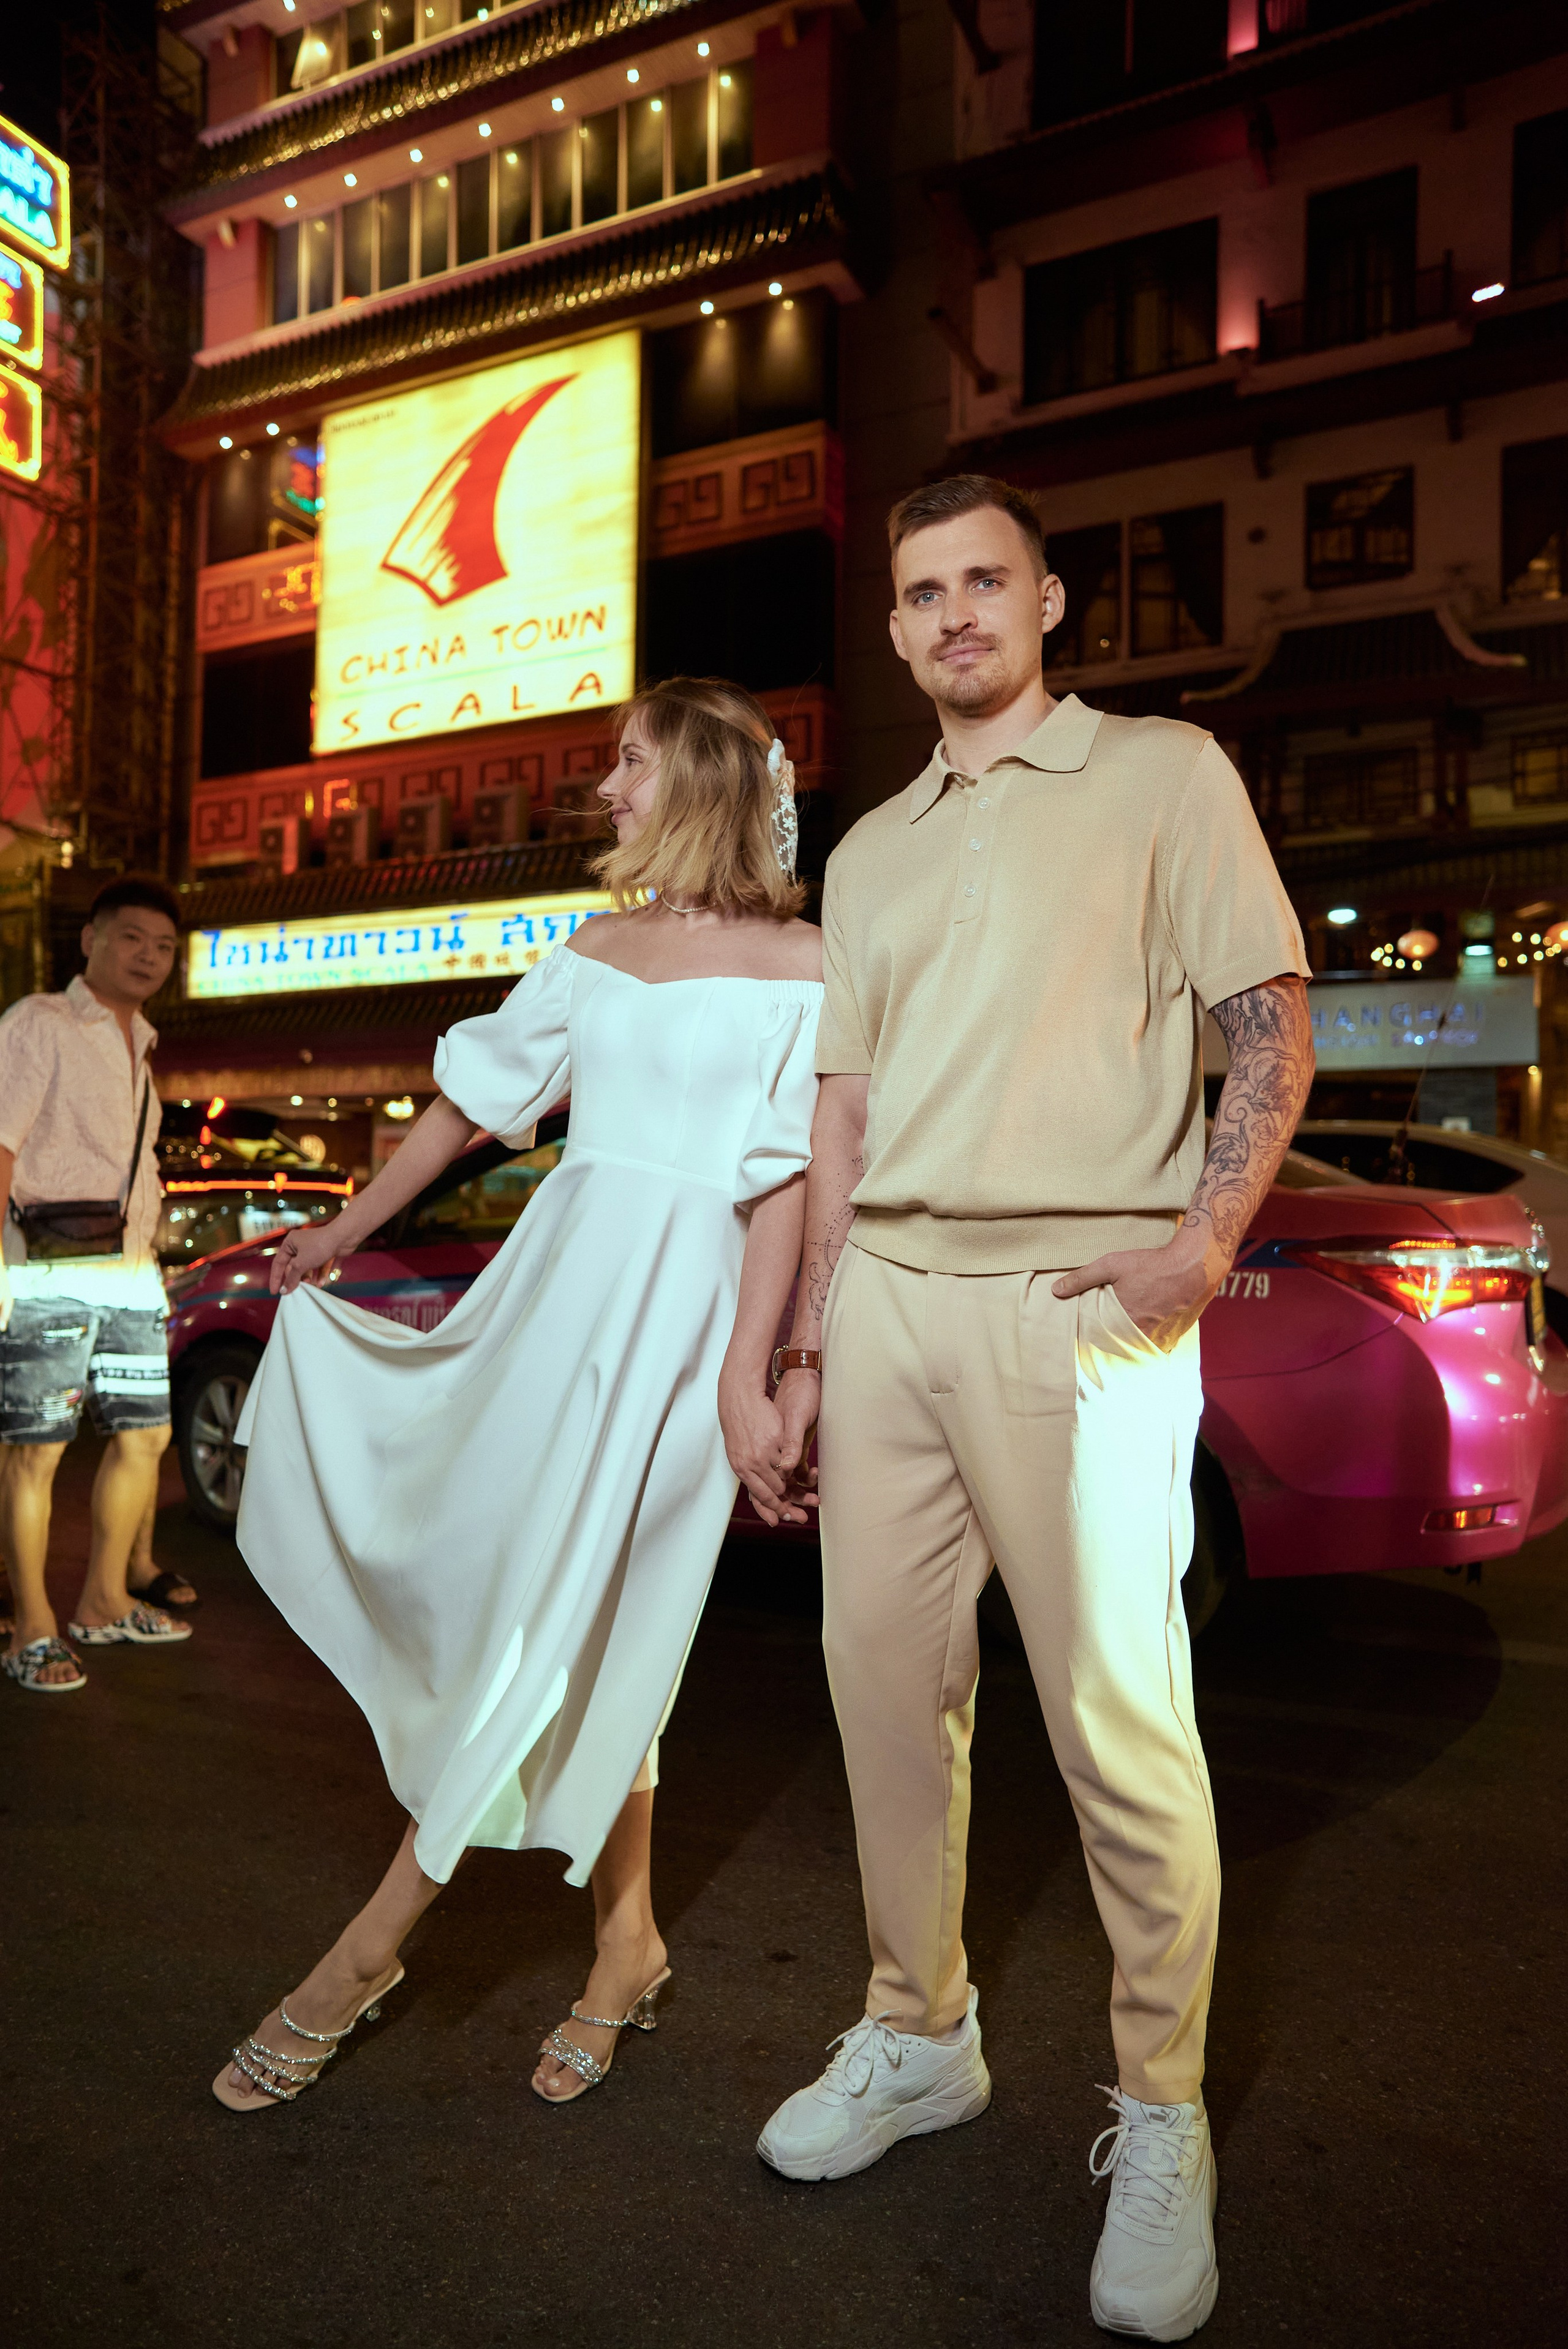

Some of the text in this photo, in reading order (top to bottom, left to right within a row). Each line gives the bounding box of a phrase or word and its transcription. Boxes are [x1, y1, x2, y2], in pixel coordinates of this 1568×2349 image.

[340, 605, 606, 684] CHINA TOWN
[340, 671, 603, 742] SCALA
[1310, 1002, 1484, 1029] HANGHAI
